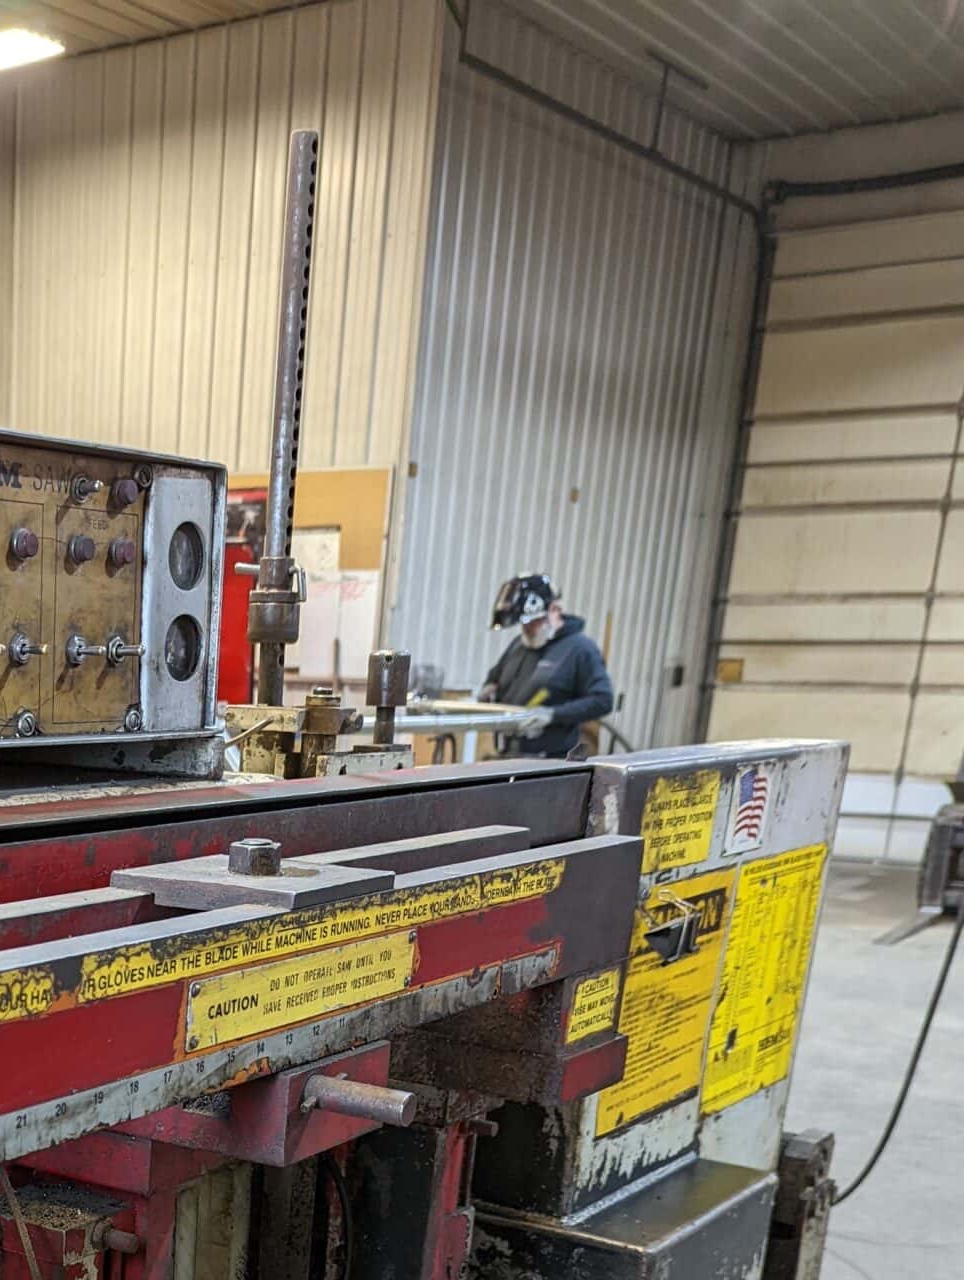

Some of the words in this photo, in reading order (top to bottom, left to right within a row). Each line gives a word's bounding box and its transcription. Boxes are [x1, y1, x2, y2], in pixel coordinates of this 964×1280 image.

[98, 966, 145, 990] GLOVES
[146, 959, 178, 979] NEAR
[180, 953, 202, 971] THE
[205, 944, 238, 966] BLADE
[241, 935, 273, 956] WHILE
[275, 925, 318, 950] MACHINE
[319, 925, 329, 939] IS
[376, 909, 401, 926] NEVER
[402, 904, 428, 921] PLACE
[523, 880, 535, 893] THE
[270, 979, 281, 992] DO
[285, 973, 300, 987] NOT
[337, 959, 353, 974] SAW
[356, 953, 374, 969] UNTIL
[379, 949, 392, 962] YOU
[585, 978, 610, 994] CAUTION
[208, 993, 259, 1020] CAUTION
[263, 999, 282, 1016] HAVE
[286, 988, 319, 1009] RECEIVED
[322, 981, 348, 998] PROPER
[587, 1000, 598, 1011] MAY
[16, 1114, 28, 1129] 21
[55, 1102, 68, 1117] 20
[92, 1091, 105, 1106] 19
[129, 1080, 140, 1094] 18
[163, 1070, 174, 1084] 17
[196, 1061, 205, 1073] 16
[227, 1051, 236, 1064] 15
[256, 1041, 266, 1054] 14
[286, 1034, 294, 1046] 13
[312, 1025, 321, 1036] 12
[339, 1018, 346, 1028] 11
